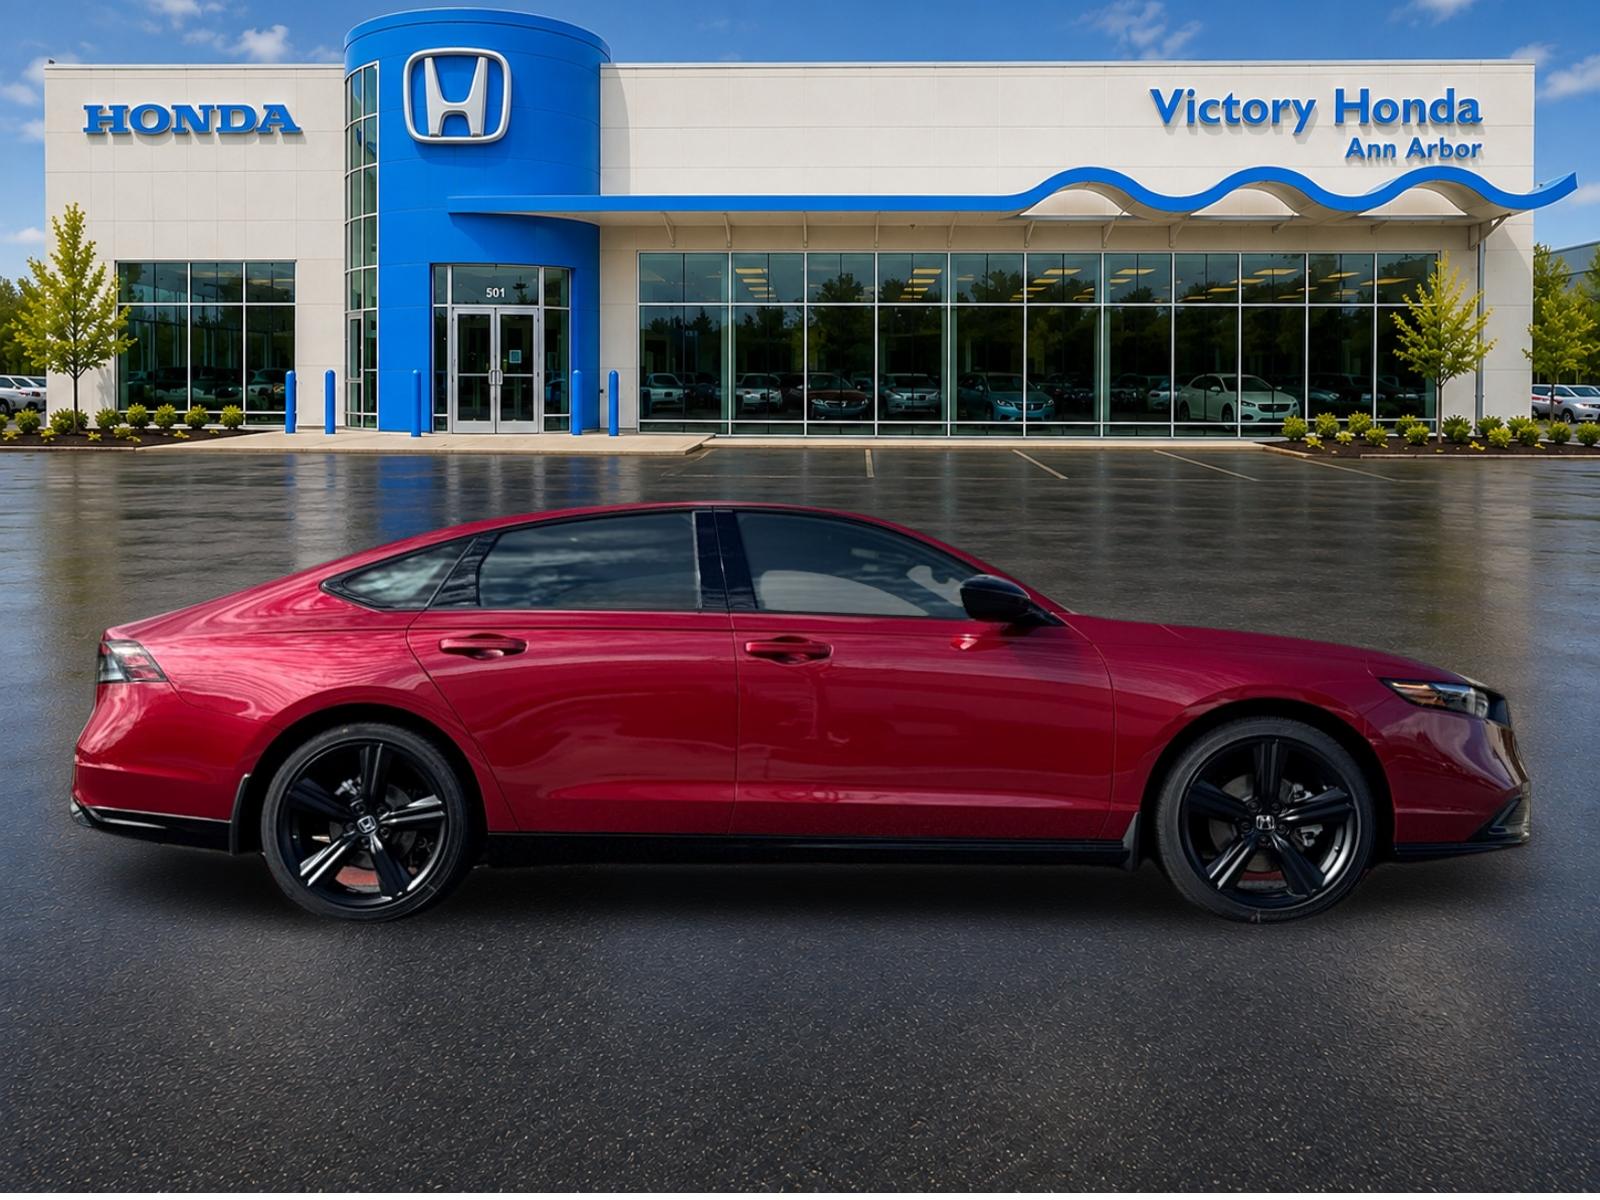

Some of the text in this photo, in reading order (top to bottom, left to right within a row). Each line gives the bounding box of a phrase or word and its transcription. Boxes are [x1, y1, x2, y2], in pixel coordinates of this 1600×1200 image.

[83, 103, 301, 135] HONDA
[1150, 87, 1484, 136] Victory Honda
[1345, 137, 1483, 160] Ann Arbor
[486, 287, 505, 298] 501
